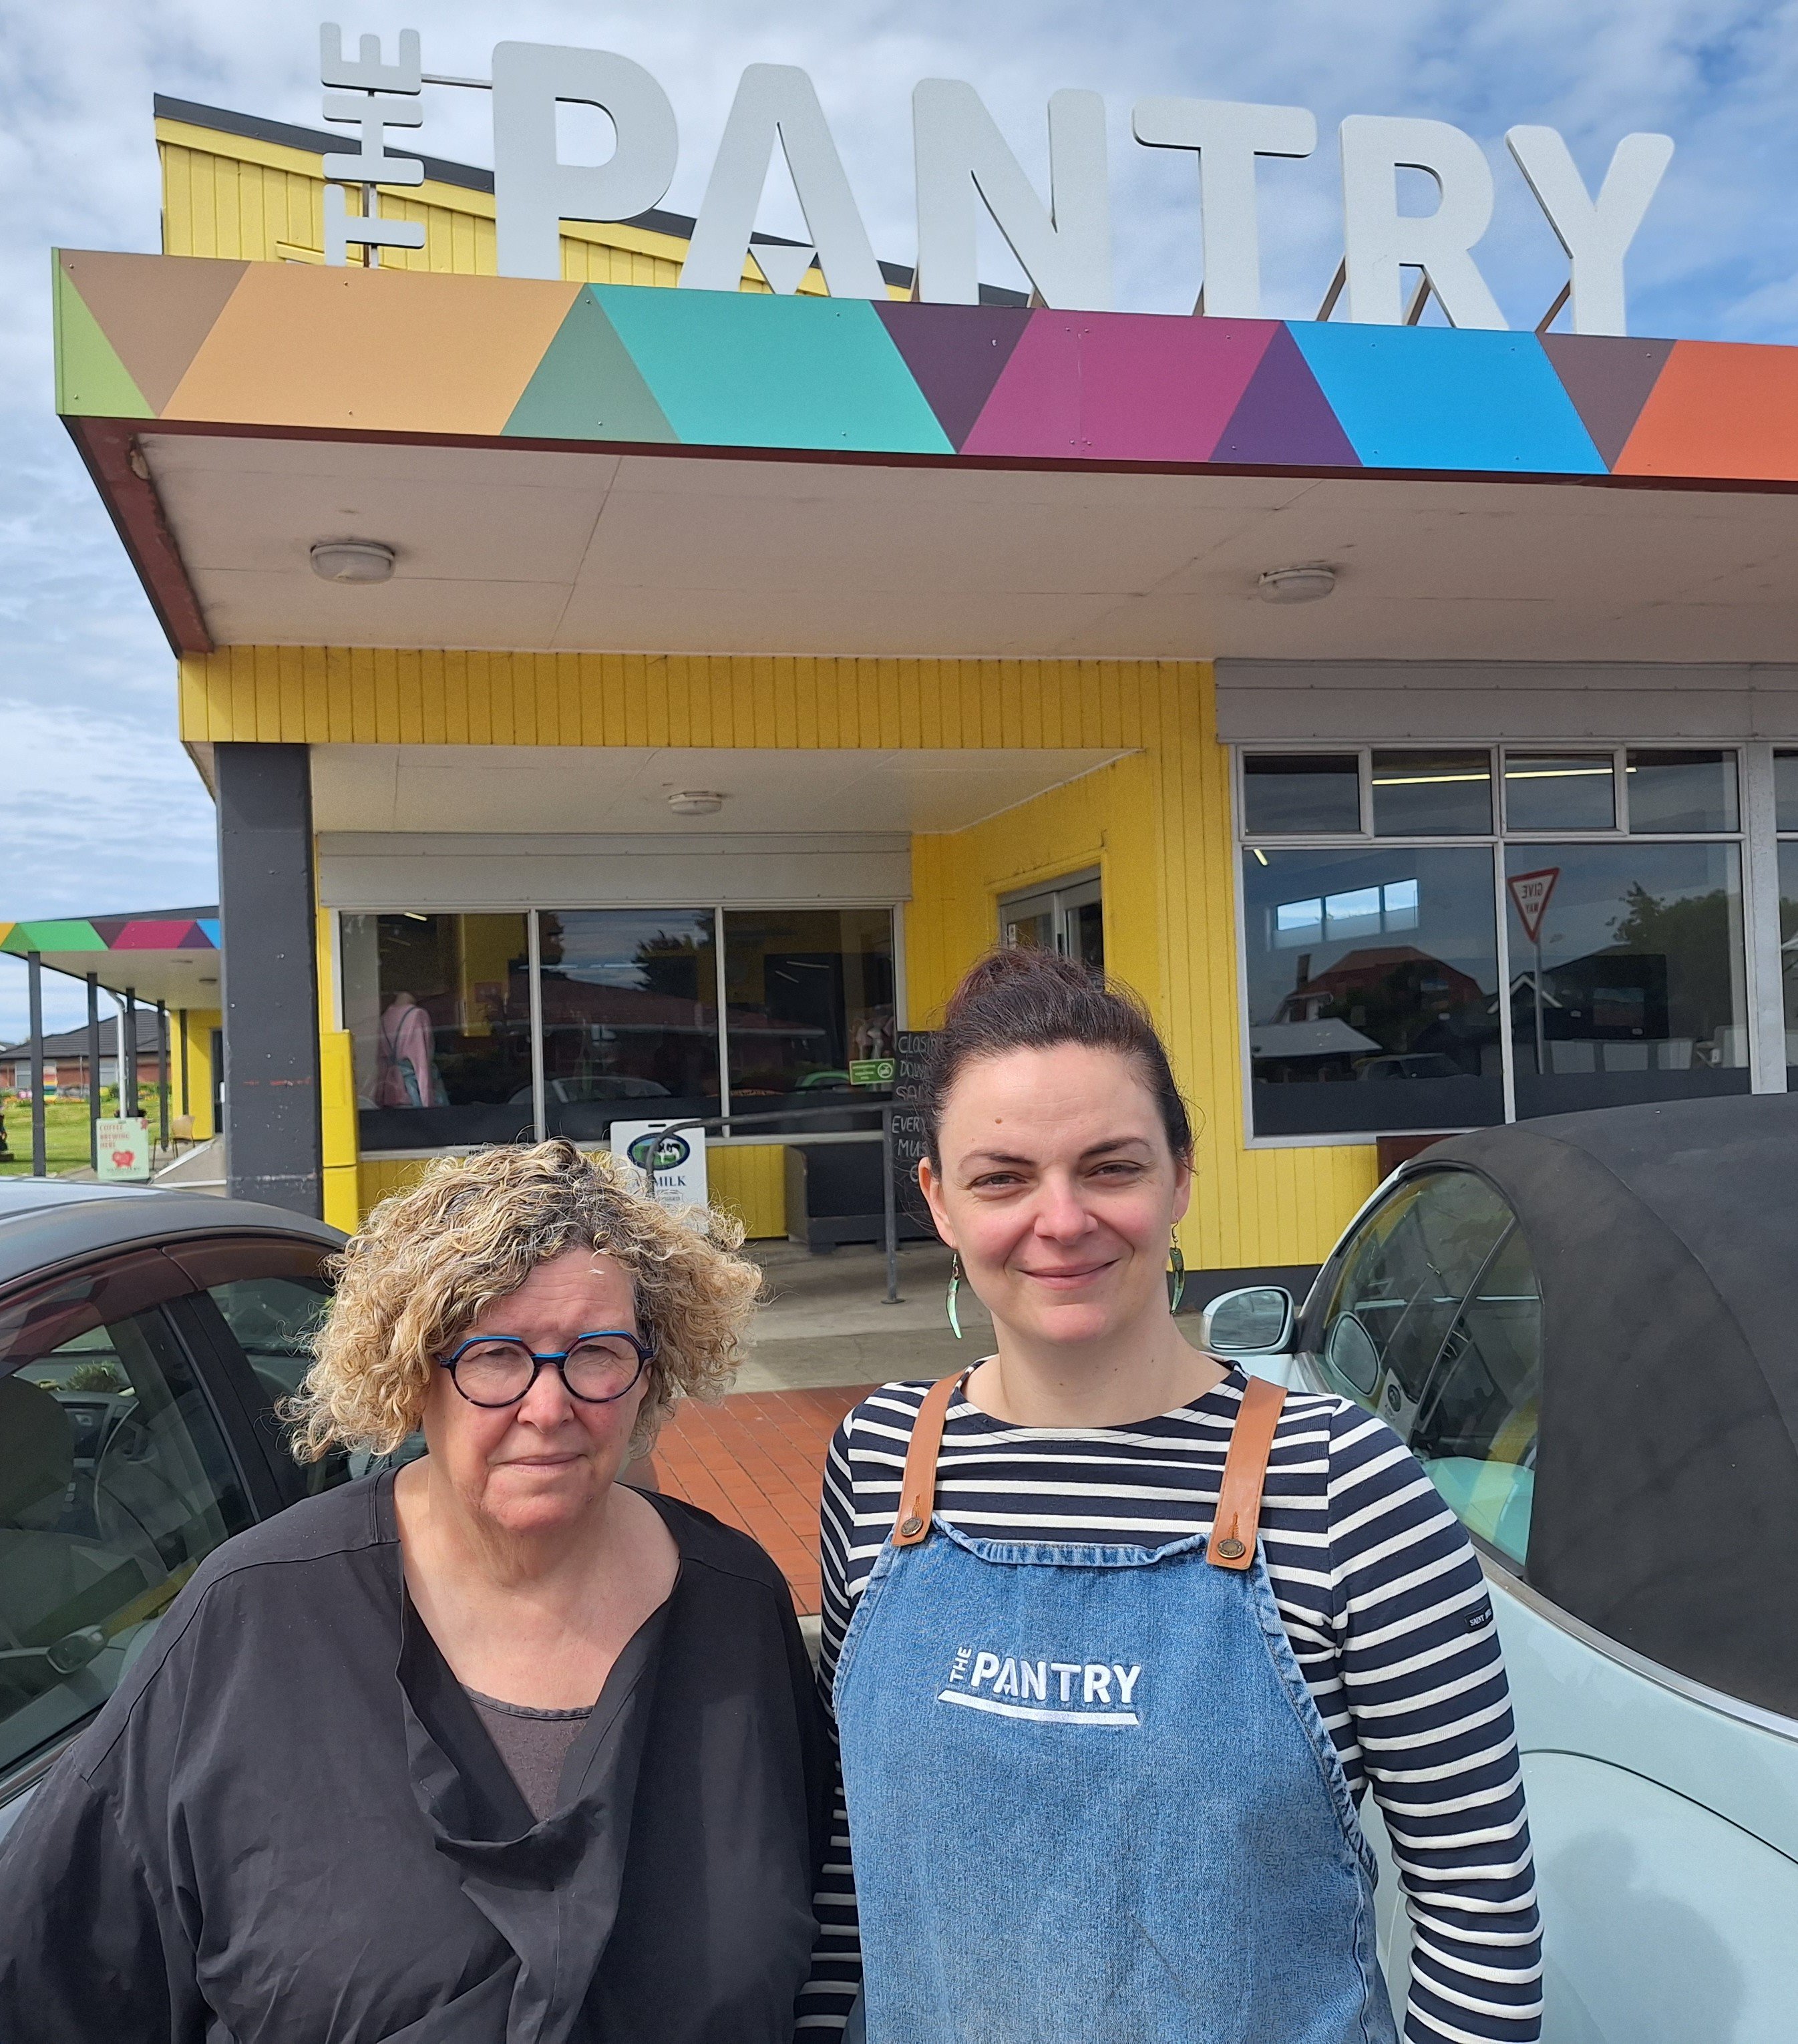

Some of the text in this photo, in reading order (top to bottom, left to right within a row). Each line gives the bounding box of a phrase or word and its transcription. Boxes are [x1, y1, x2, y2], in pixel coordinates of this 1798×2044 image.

[321, 22, 1674, 336] THE PANTRY
[949, 1647, 1141, 1703] THE PANTRY
